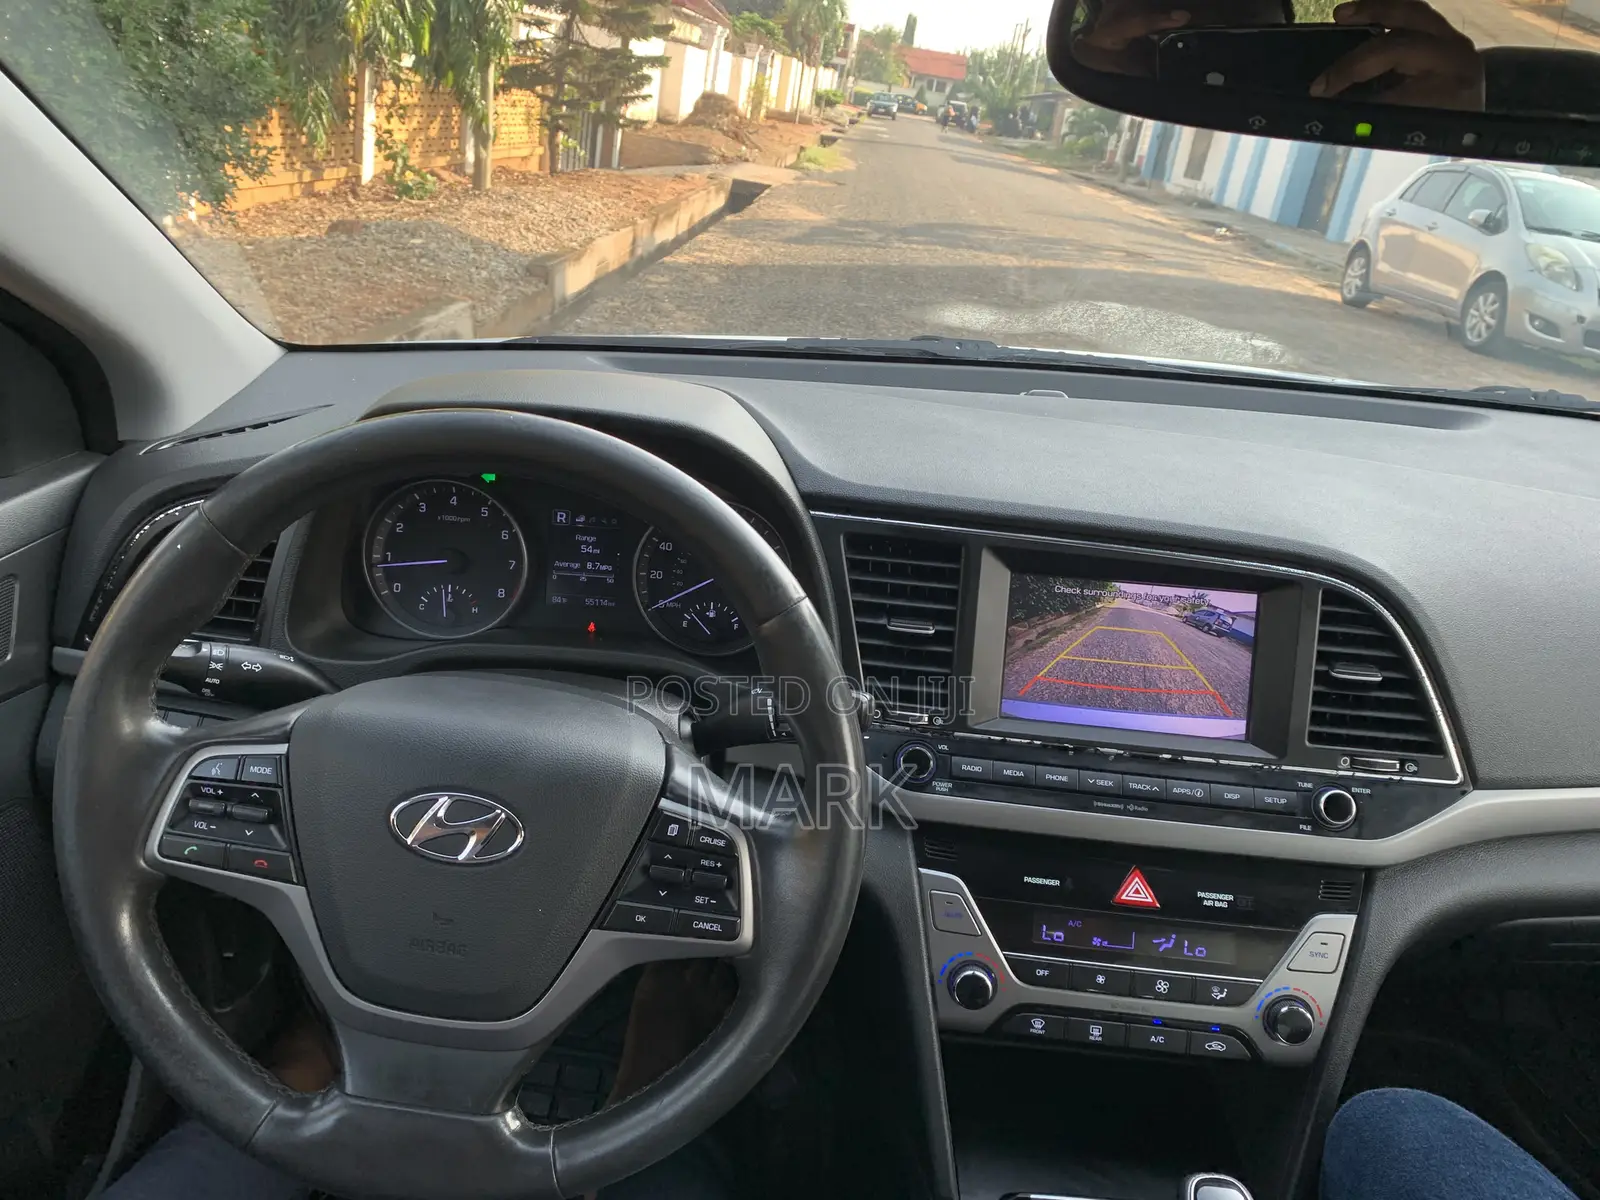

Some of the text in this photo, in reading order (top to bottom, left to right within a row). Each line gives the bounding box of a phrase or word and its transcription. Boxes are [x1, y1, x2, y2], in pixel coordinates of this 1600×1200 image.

[449, 496, 458, 506] 4
[418, 502, 427, 512] 3
[481, 507, 489, 517] 5
[556, 512, 566, 523] R
[396, 523, 404, 533] 2
[501, 530, 509, 540] 6
[575, 534, 597, 543] Range
[659, 542, 673, 551] 40
[385, 552, 392, 561] 1
[508, 560, 516, 570] 7
[554, 561, 580, 569] Average
[650, 571, 663, 580] 20
[393, 583, 401, 593] 0
[497, 588, 505, 598] 8
[1054, 585, 1209, 606] Check surroundings for your safety
[472, 606, 478, 614] H
[682, 620, 688, 628] E
[205, 677, 220, 685] AUTO
[250, 765, 273, 775] MODE
[961, 764, 982, 773] RADIO
[1003, 769, 1025, 778] MEDIA
[1045, 774, 1069, 783] PHONE
[1096, 779, 1114, 787] SEEK
[932, 781, 953, 789] POWER
[1128, 782, 1151, 791] TRACK
[1297, 781, 1313, 789] TUNE
[1352, 787, 1371, 795] ENTER
[1224, 792, 1240, 800] DISP
[1264, 796, 1287, 805] SETUP
[1299, 824, 1312, 832] FILE
[700, 835, 726, 847] CRUISE
[1024, 876, 1061, 887] PASSENGER
[1197, 891, 1234, 901] PASSENGER
[1215, 900, 1228, 908] BAG
[635, 914, 646, 922] OK
[693, 921, 722, 932] CANCEL
[1068, 920, 1082, 928] A/C
[1309, 950, 1329, 959] SYNC
[1036, 969, 1050, 977] OFF
[1150, 1035, 1165, 1043] A/C
